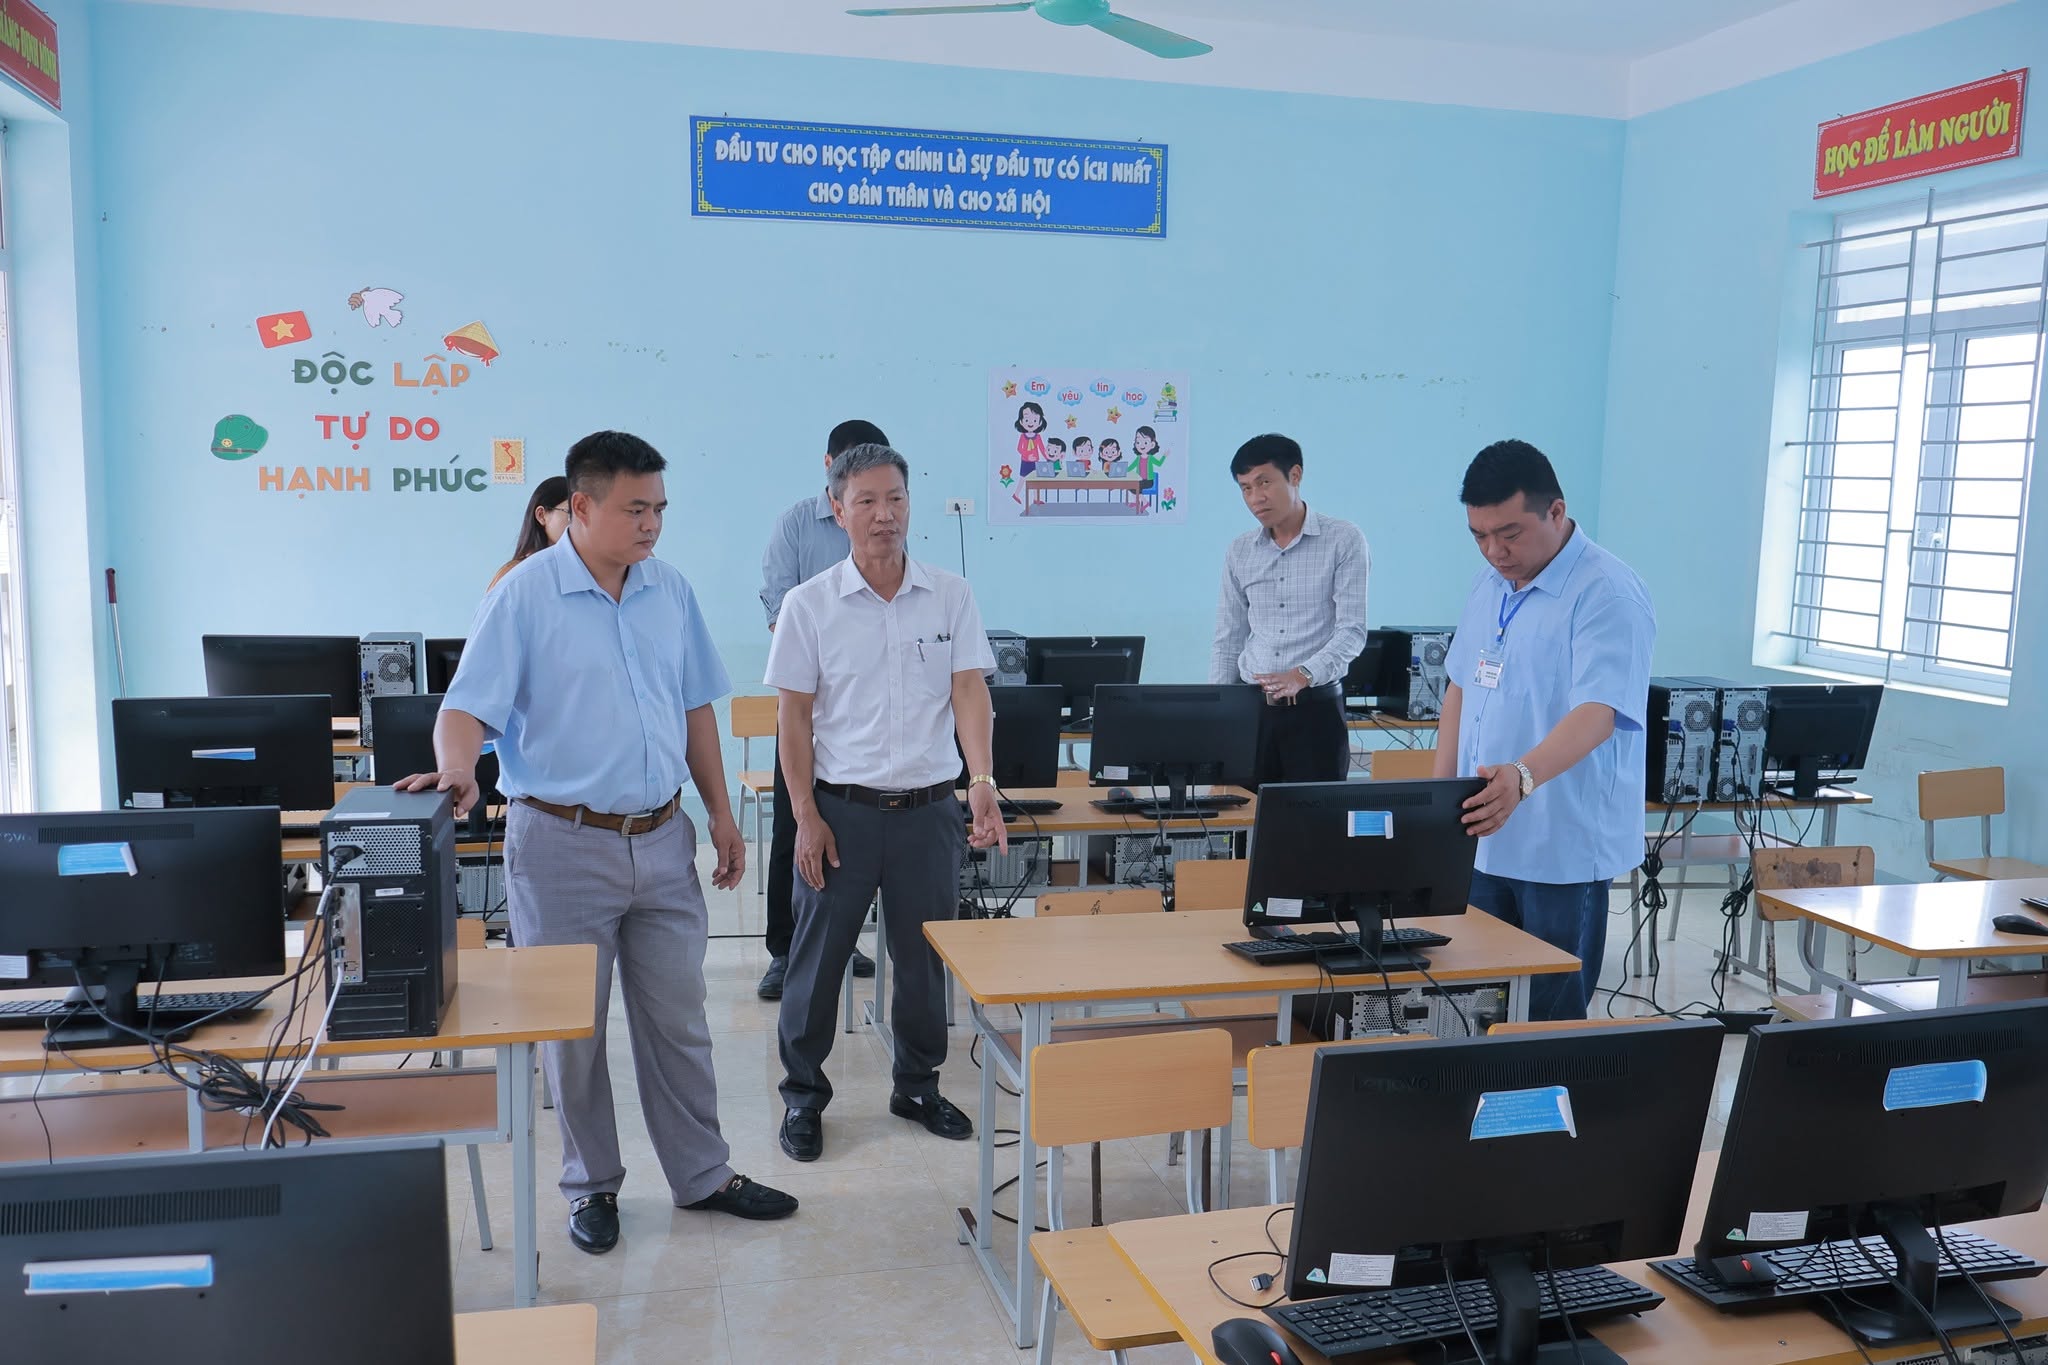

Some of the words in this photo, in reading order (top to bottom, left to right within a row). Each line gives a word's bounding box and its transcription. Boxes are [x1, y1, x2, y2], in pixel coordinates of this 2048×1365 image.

[1823, 141, 1860, 178] HỌC
[1863, 117, 1890, 166] ĐỂ
[1893, 118, 1936, 159] LÀM
[1938, 97, 2012, 149] NGƯỜI
[715, 132, 751, 162] ĐẦU
[756, 141, 778, 163] TƯ
[782, 143, 817, 165] CHO
[822, 145, 857, 173] HỌC
[861, 143, 891, 175] TẬP
[895, 146, 943, 172] CHÍNH
[947, 148, 966, 174] LÀ
[971, 153, 993, 182] SỰ
[996, 148, 1029, 177] ĐẦU
[1033, 157, 1055, 178] TƯ
[1057, 154, 1080, 180] CÓ
[1083, 155, 1107, 182] ÍCH
[1112, 157, 1152, 185] NHẤT
[808, 181, 844, 204] CHO
[848, 177, 882, 206] BẢN
[886, 182, 929, 209] THÂN
[932, 184, 954, 210] VÀ
[958, 189, 992, 212] CHO
[995, 188, 1017, 213] XÃ
[1021, 189, 1051, 220] HỘI
[291, 351, 375, 395] ĐỘC
[393, 353, 470, 395] LẬP
[1031, 382, 1046, 391] Em
[1097, 382, 1109, 392] tin
[1062, 390, 1079, 401] yêu
[1125, 392, 1143, 402] học
[314, 410, 370, 450] TỰ
[389, 416, 440, 441] DO
[258, 466, 370, 499] HẠNH
[393, 454, 488, 492] PHÚC
